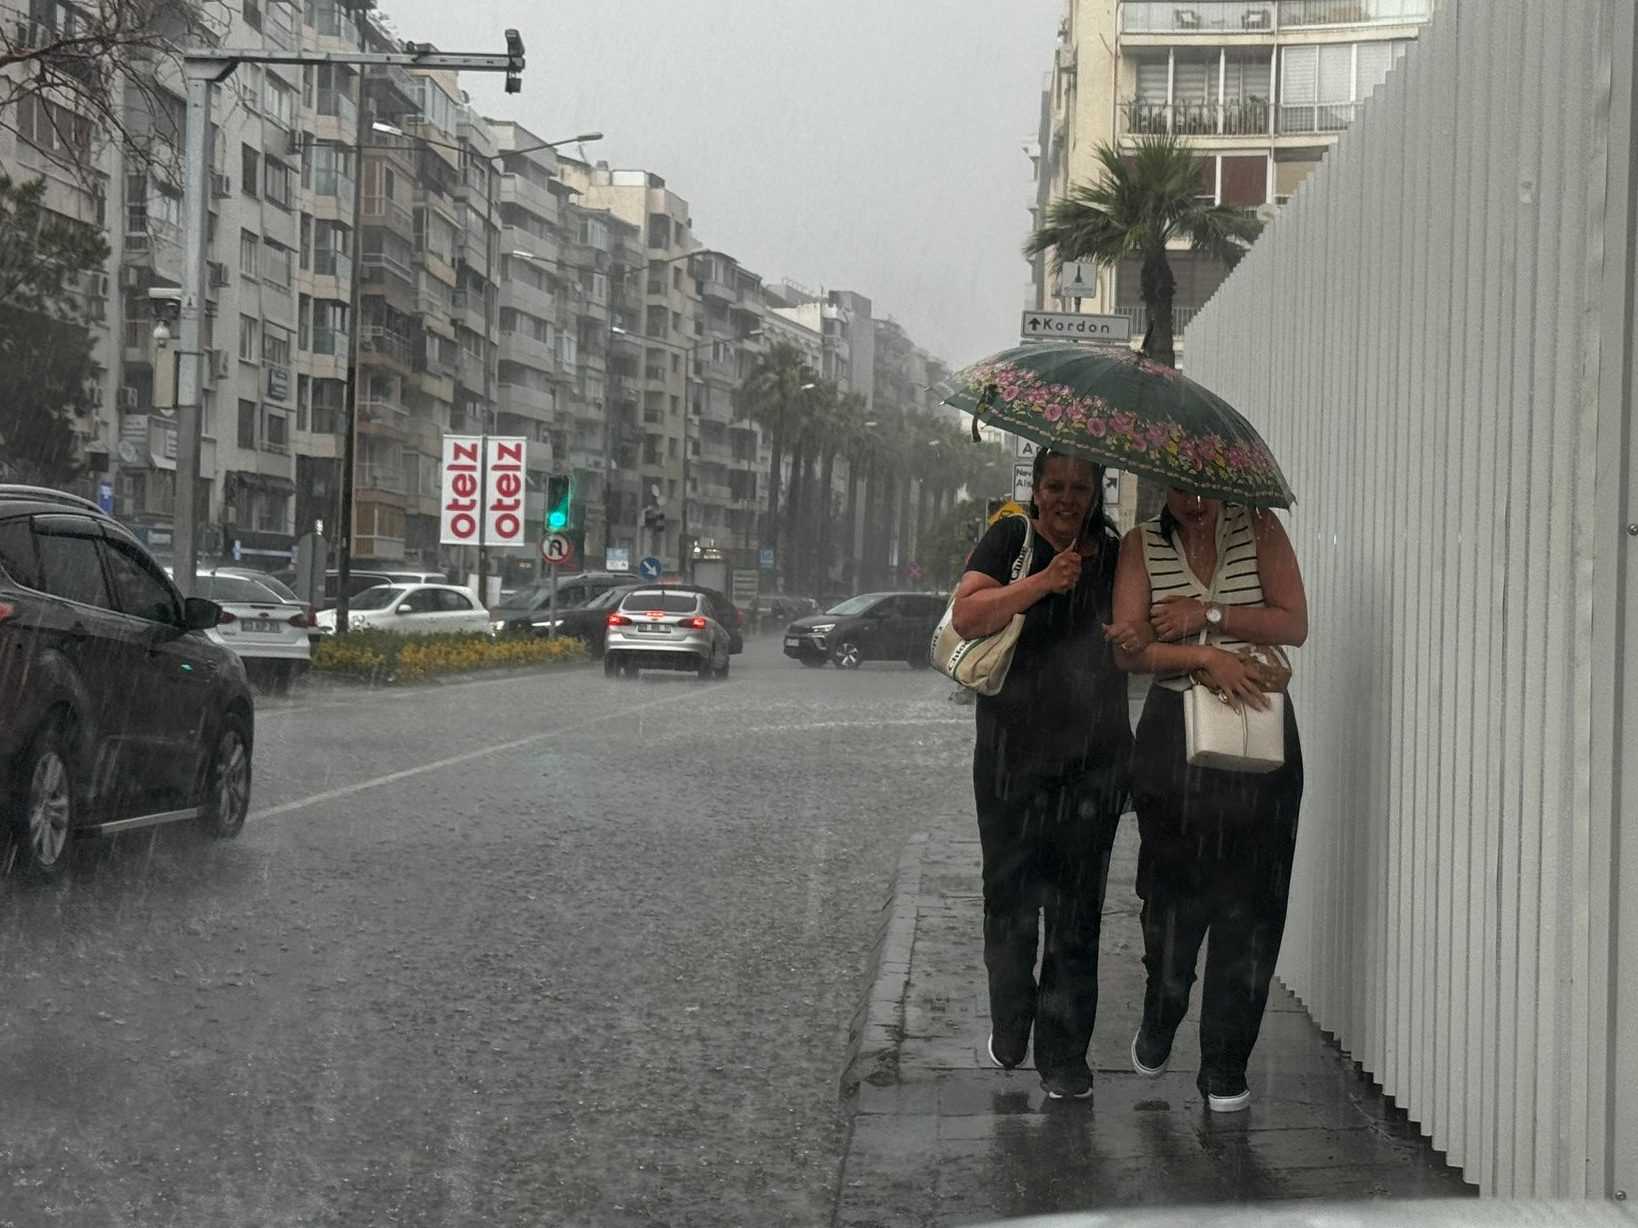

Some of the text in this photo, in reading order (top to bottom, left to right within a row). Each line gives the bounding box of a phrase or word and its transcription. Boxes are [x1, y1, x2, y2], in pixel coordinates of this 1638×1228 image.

[1042, 318, 1110, 334] Kordon
[446, 442, 478, 539] otelz
[490, 442, 522, 539] otelz
